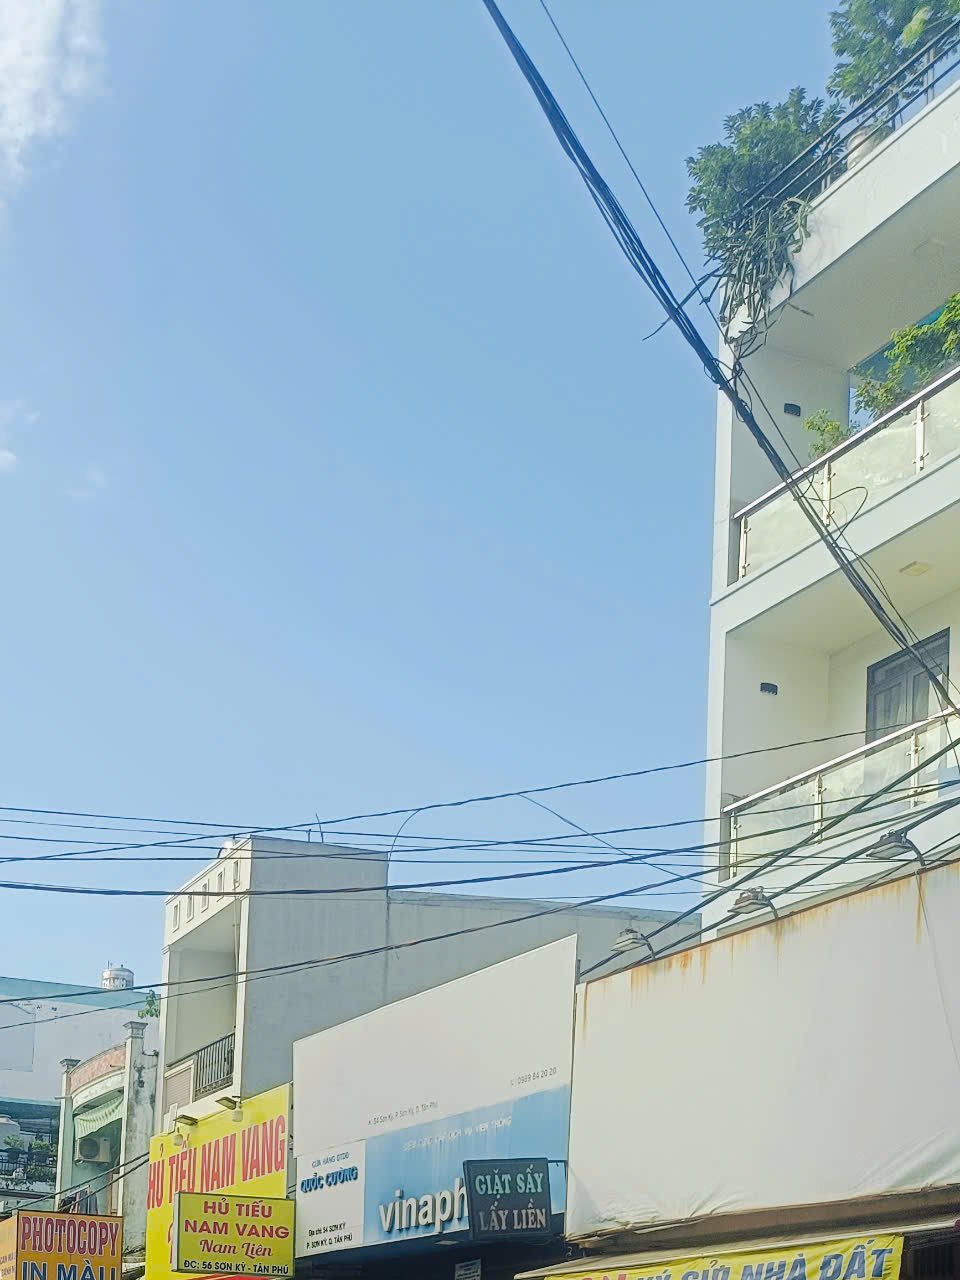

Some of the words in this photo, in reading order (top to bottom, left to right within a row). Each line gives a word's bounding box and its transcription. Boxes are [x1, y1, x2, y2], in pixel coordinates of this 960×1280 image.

[147, 1144, 165, 1210] HỦ
[200, 1133, 237, 1194] NAM
[241, 1114, 286, 1182] VANG
[475, 1168, 511, 1199] GIẶT
[516, 1164, 544, 1193] SẤY
[203, 1198, 230, 1215] HỦ
[235, 1200, 272, 1218] TIẾU
[379, 1176, 468, 1235] vinaph
[479, 1201, 509, 1231] LẤY
[513, 1198, 547, 1230] LIỀN
[21, 1216, 119, 1257] PHOTOCOPY
[184, 1219, 229, 1235] NAM
[235, 1223, 290, 1239] VANG
[199, 1239, 238, 1255] Nam
[241, 1242, 273, 1260] Liên
[183, 1260, 200, 1270] ĐC:
[202, 1261, 212, 1270] 56
[214, 1260, 233, 1271] SƠN
[235, 1260, 246, 1272] KỲ
[253, 1262, 270, 1274] TÂN
[271, 1263, 289, 1275] PHÚ
